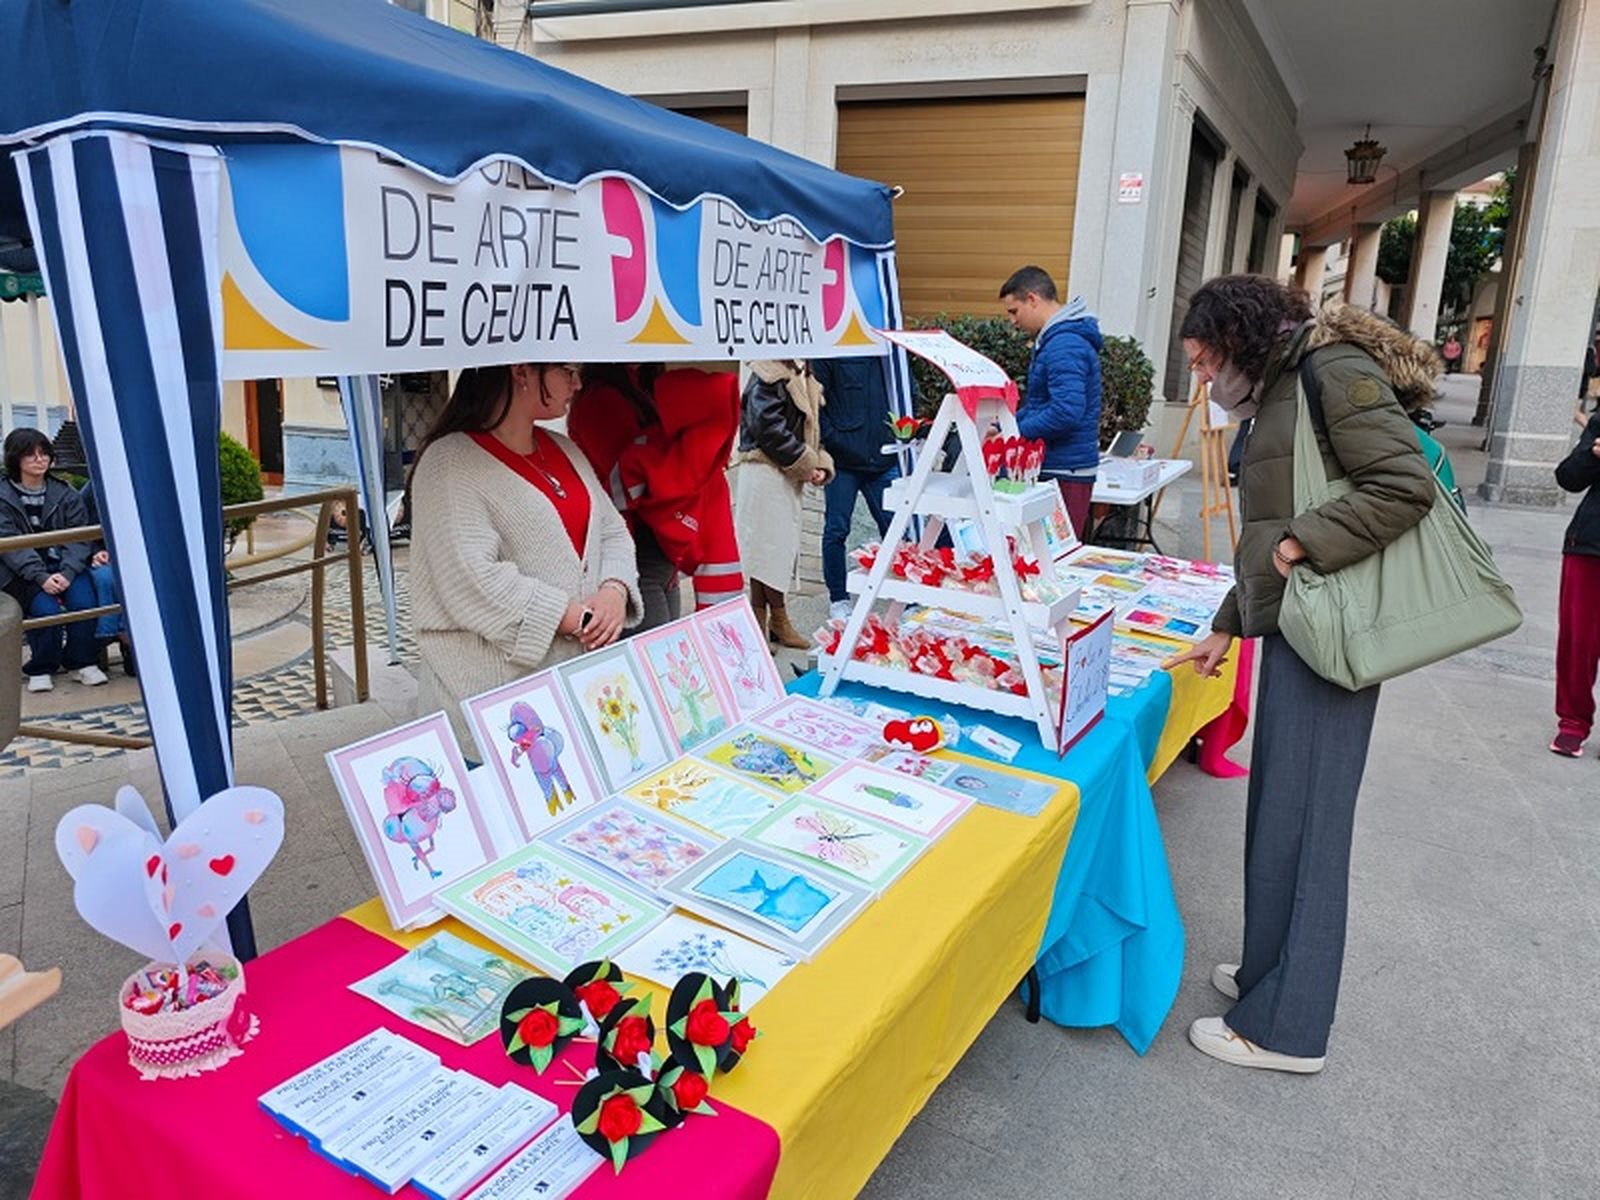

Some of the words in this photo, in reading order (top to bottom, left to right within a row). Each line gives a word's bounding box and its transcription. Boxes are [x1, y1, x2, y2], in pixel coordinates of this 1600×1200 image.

[381, 185, 458, 264] DE
[474, 201, 580, 270] ARTE
[714, 239, 752, 289] DE
[756, 247, 813, 294] ARTE
[385, 279, 447, 347] DE
[461, 282, 579, 346] CEUTA
[714, 298, 745, 344] DE
[750, 300, 813, 345] CEUTA
